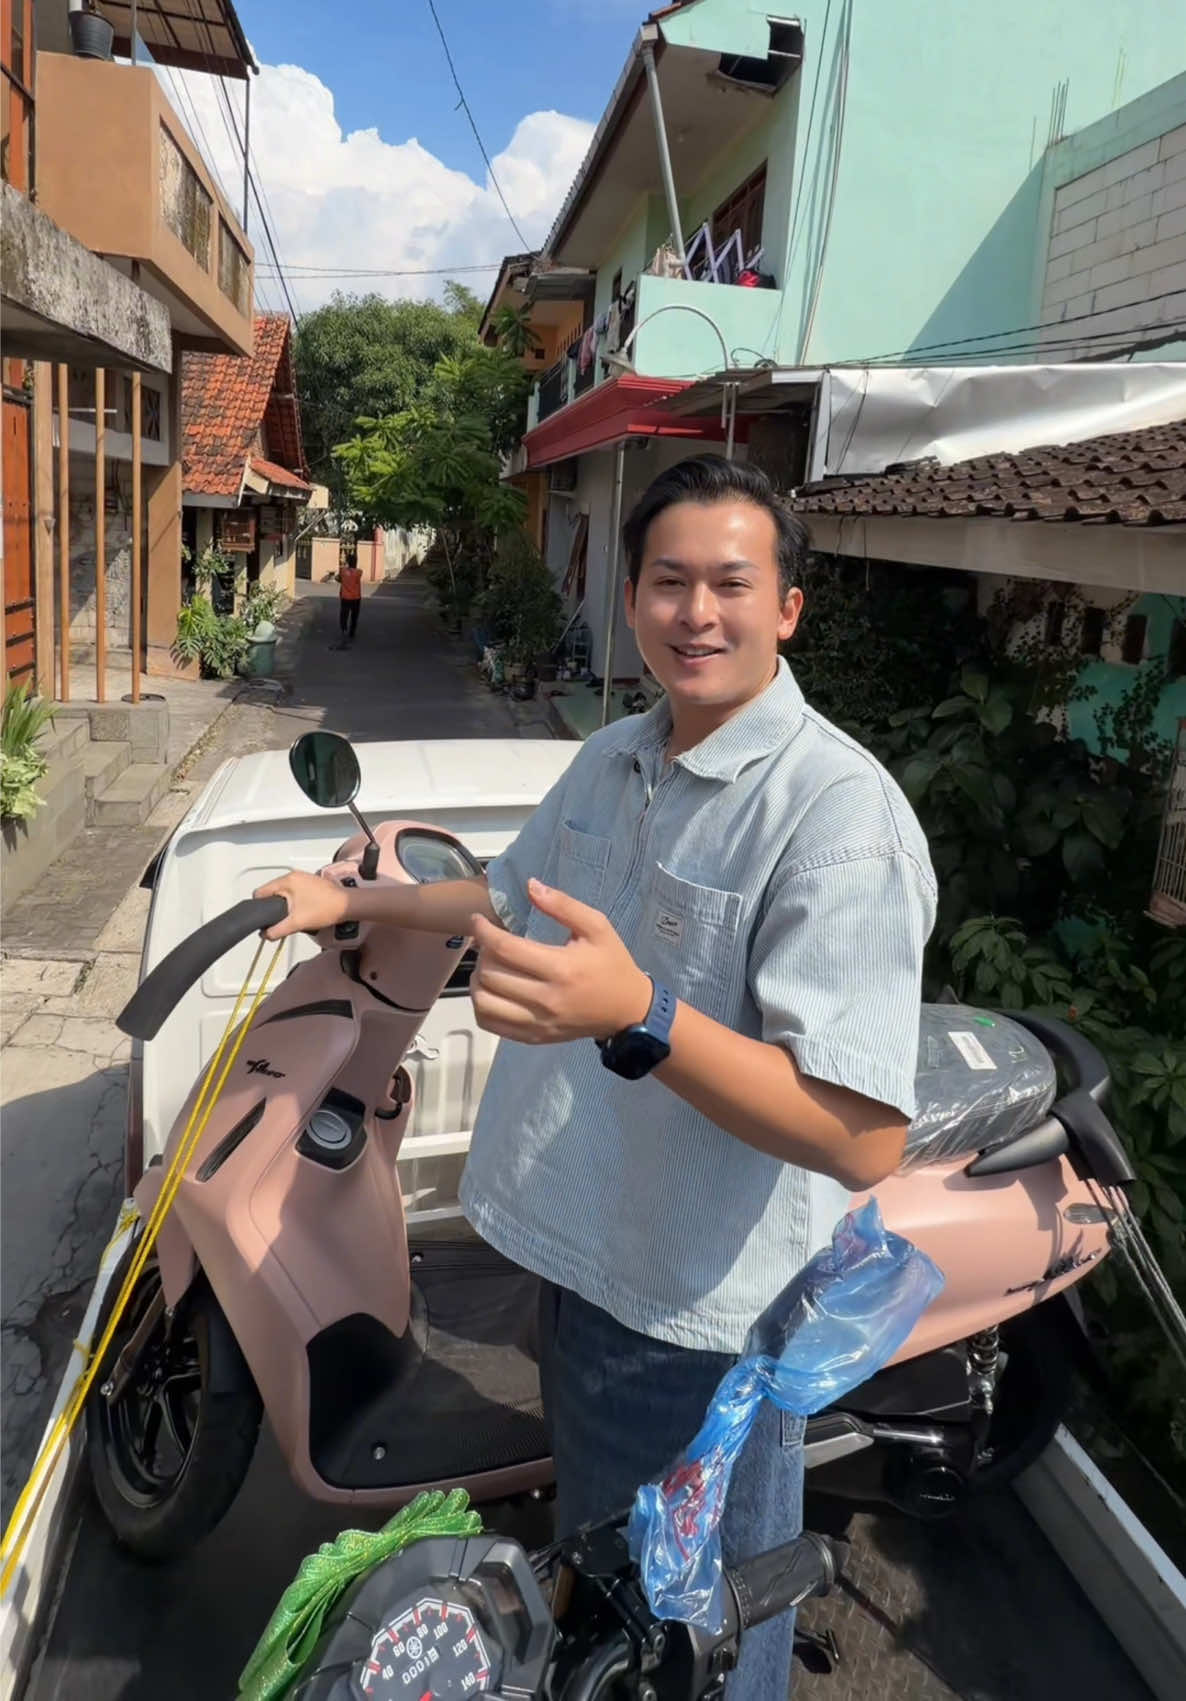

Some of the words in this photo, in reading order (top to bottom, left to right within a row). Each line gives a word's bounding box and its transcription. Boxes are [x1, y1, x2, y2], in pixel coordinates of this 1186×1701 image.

[416, 1623, 429, 1638] 80
[433, 1622, 448, 1640] 100
[392, 1641, 406, 1657] 60
[452, 1638, 468, 1657] 120
[382, 1664, 394, 1680] 40
[460, 1671, 475, 1690] 140
